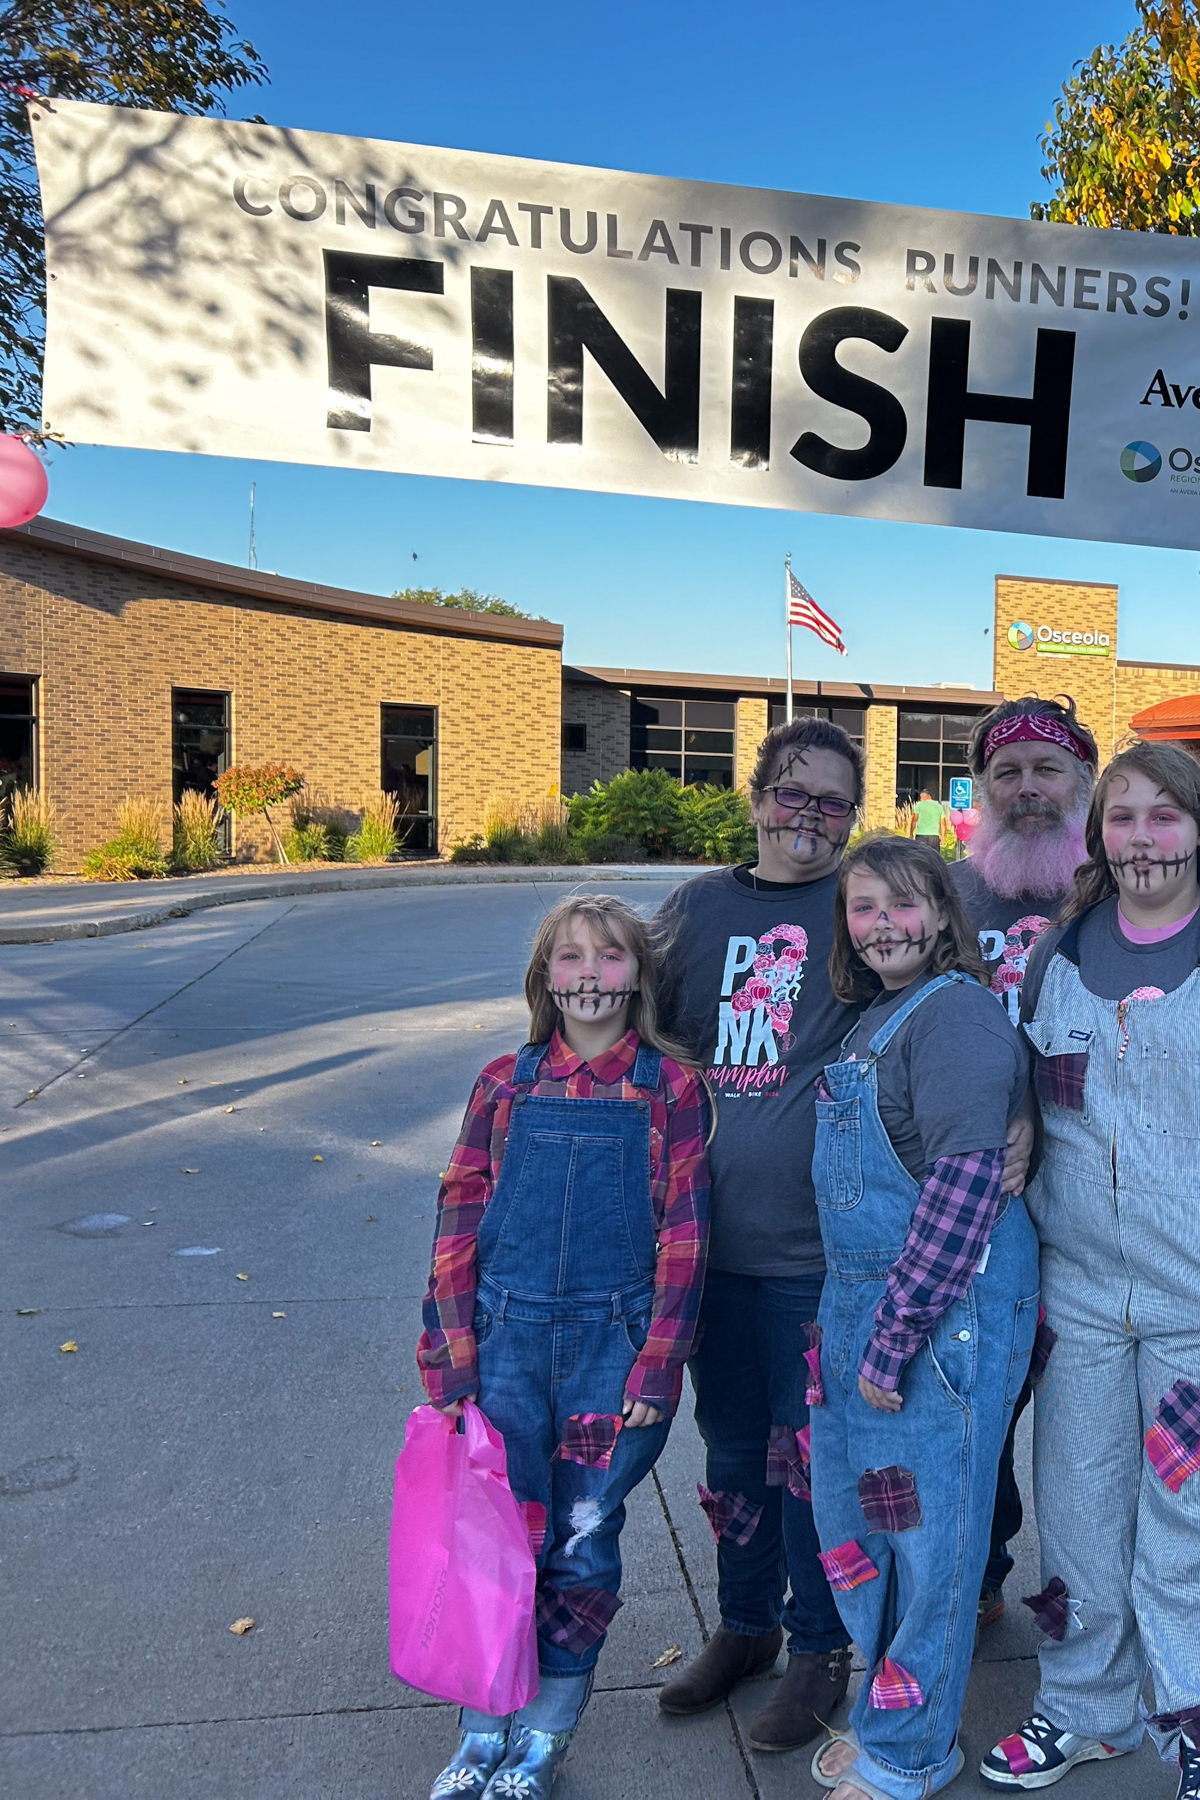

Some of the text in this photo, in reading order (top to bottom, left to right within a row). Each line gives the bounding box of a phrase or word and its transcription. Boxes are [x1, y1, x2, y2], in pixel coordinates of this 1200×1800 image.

[232, 174, 1192, 321] CONGRATULATIONS RUNNERS!
[321, 247, 1077, 500] FINISH
[1037, 625, 1110, 647] Osceola
